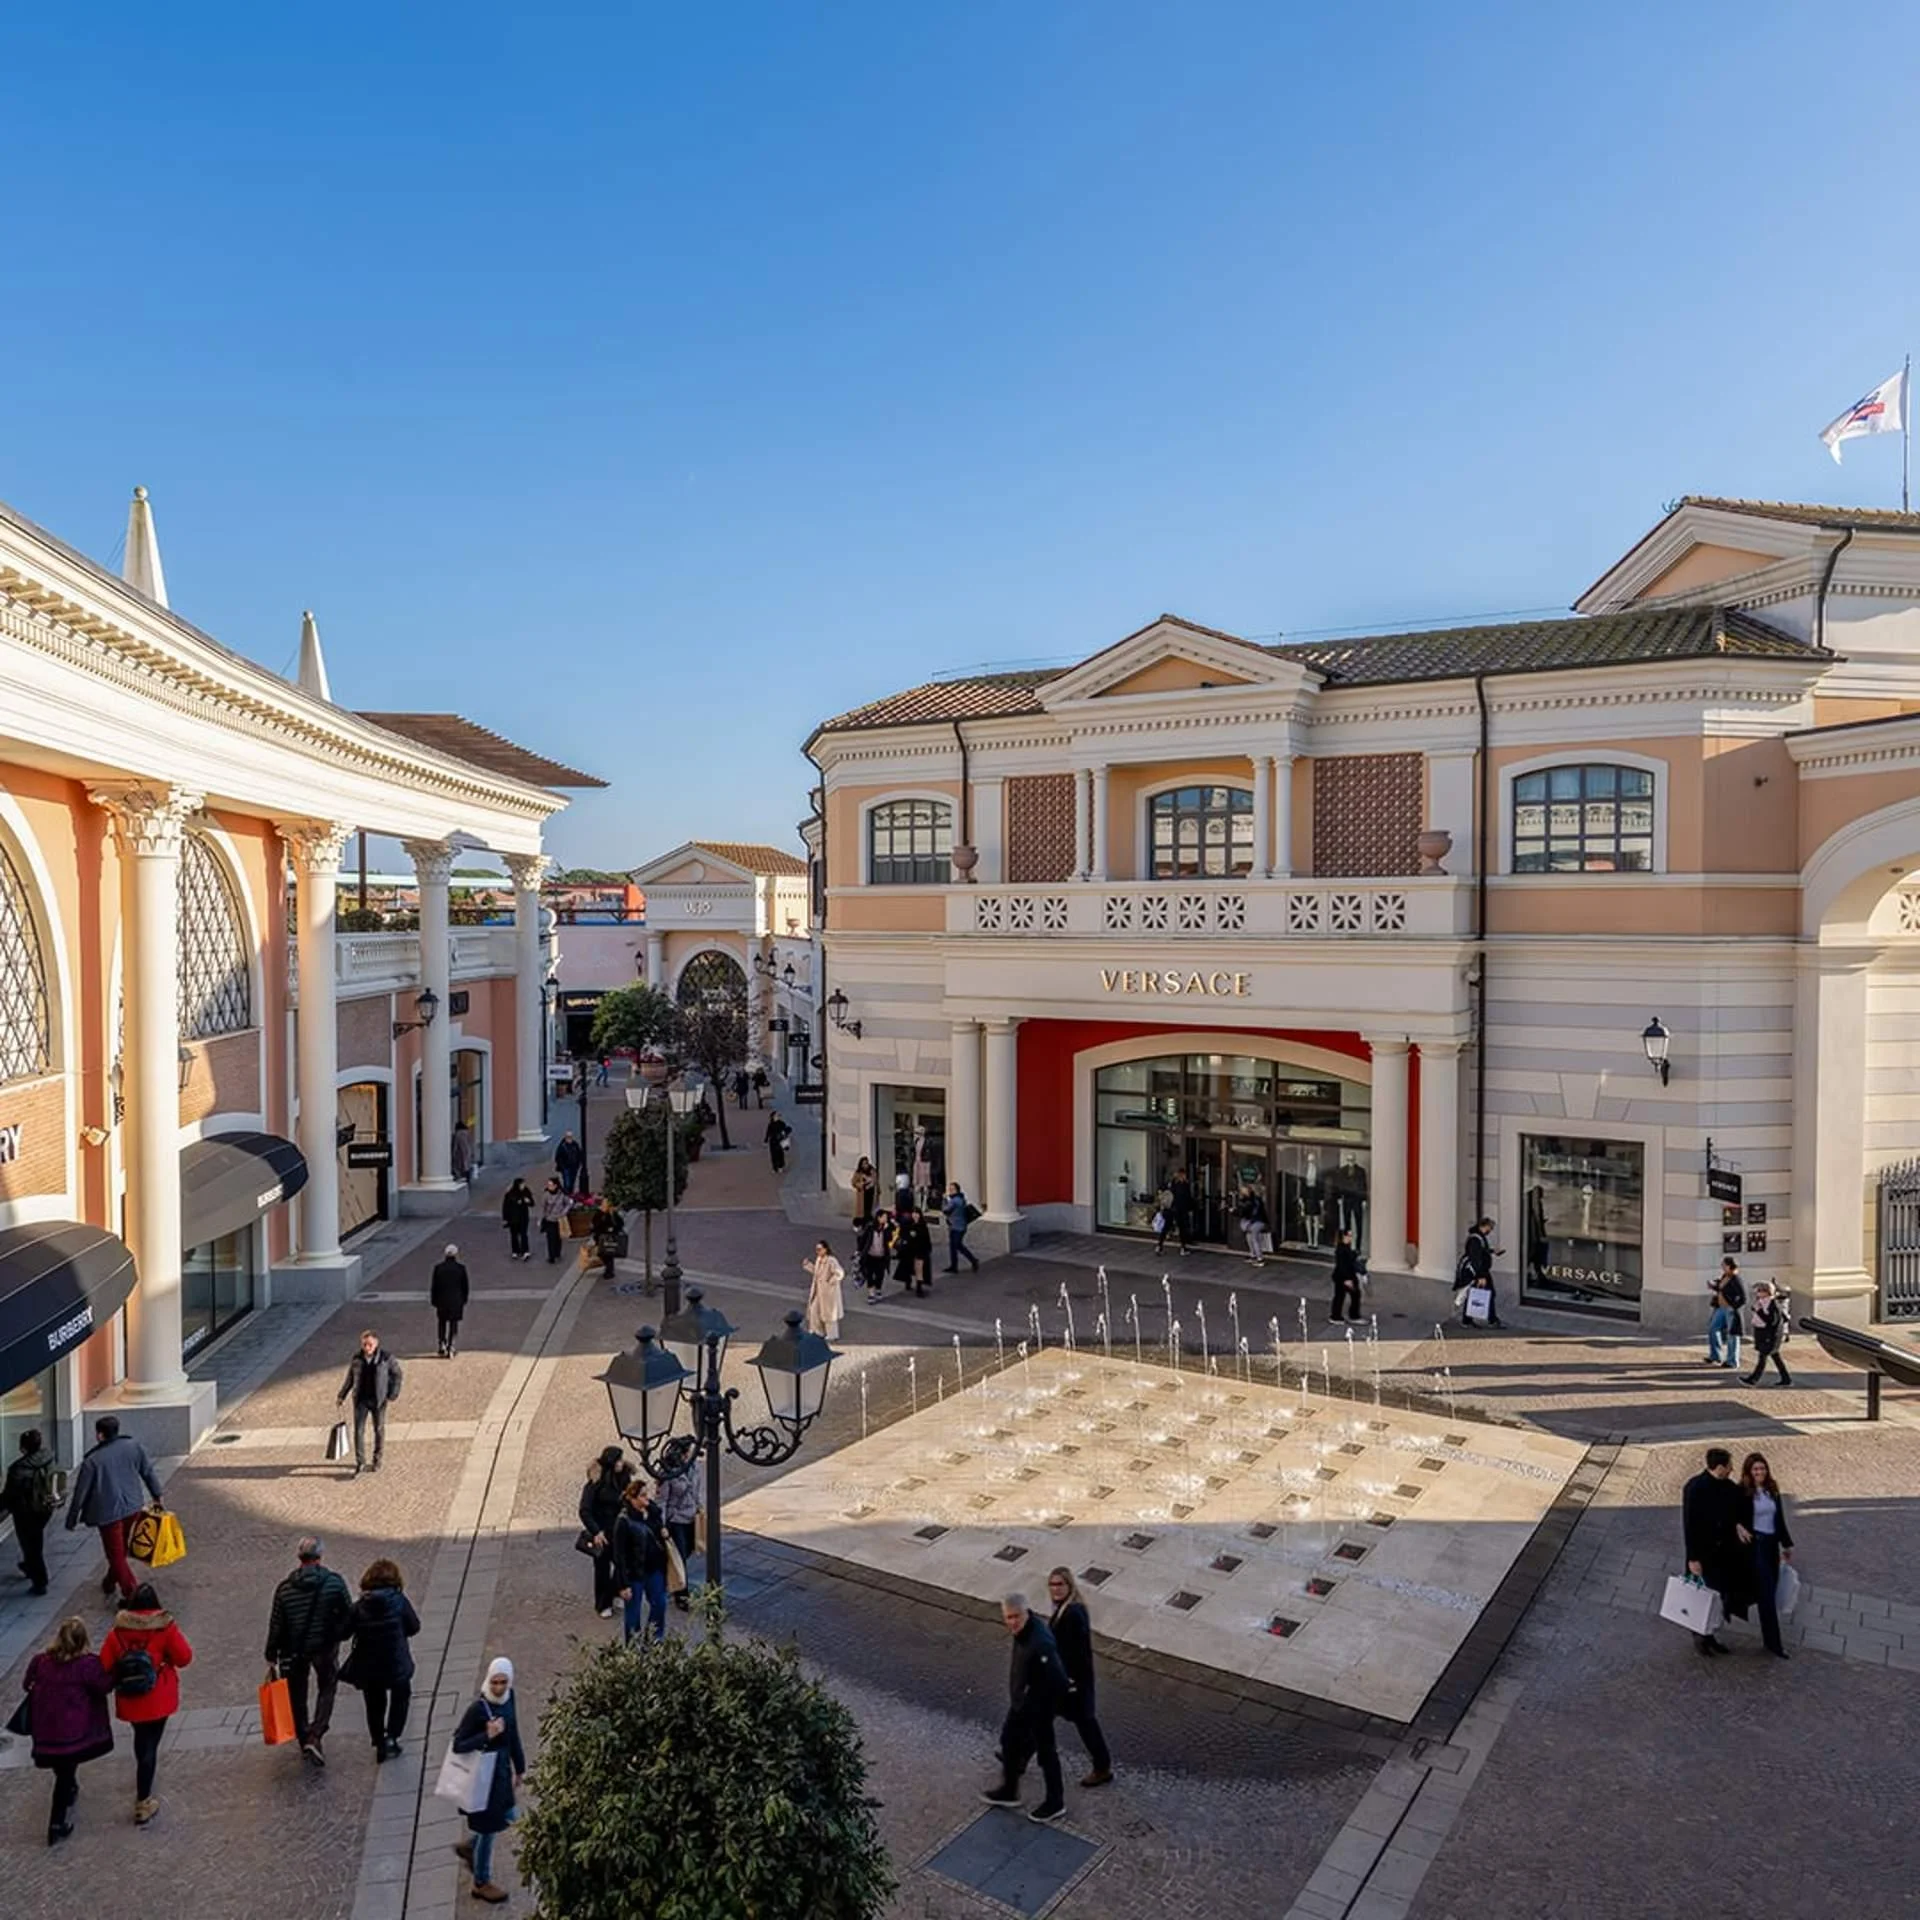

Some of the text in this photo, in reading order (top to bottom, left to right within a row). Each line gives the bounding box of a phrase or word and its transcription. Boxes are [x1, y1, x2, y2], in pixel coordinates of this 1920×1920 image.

[1100, 968, 1252, 997] VERSACE
[1540, 1265, 1624, 1285] VERSACE
[47, 1305, 93, 1351] BURBERRY
